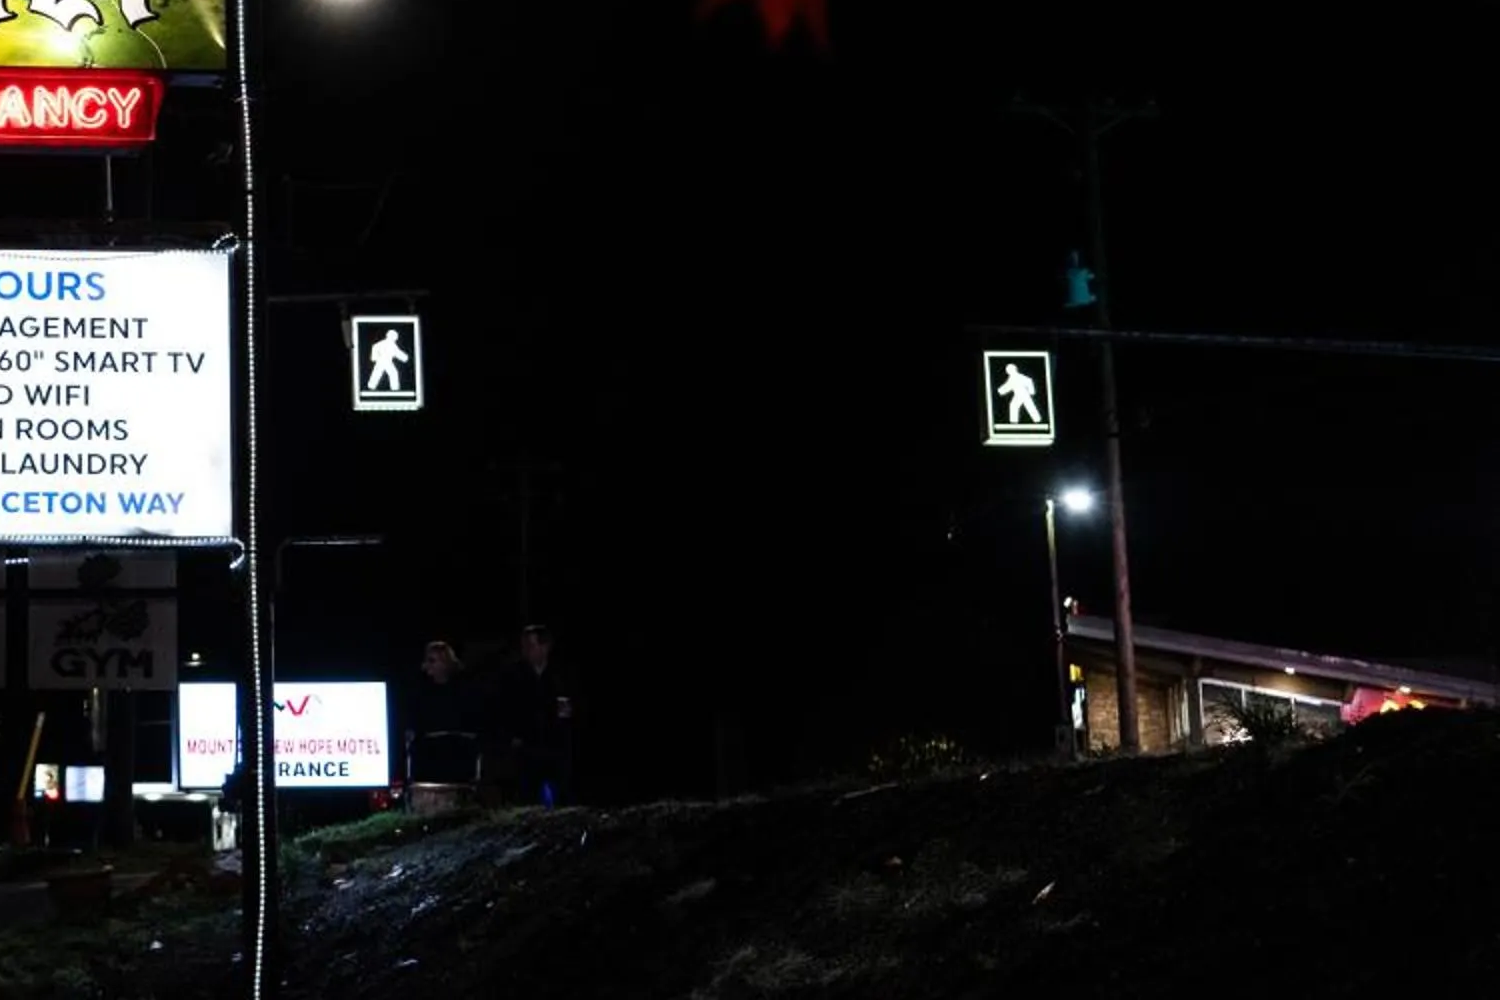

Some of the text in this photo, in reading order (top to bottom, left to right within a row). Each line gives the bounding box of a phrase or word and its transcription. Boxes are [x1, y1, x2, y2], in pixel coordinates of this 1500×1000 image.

[55, 351, 157, 373] SMART
[168, 352, 205, 374] TV
[24, 384, 90, 407] WIFI
[16, 418, 129, 441] ROOMS
[1, 453, 148, 476] LAUNDRY
[117, 492, 185, 515] WAY
[51, 649, 153, 678] GYM
[187, 738, 235, 755] MOUNT
[299, 738, 333, 755] HOPE
[337, 738, 381, 755] MOTEL
[278, 760, 350, 777] RANCE
